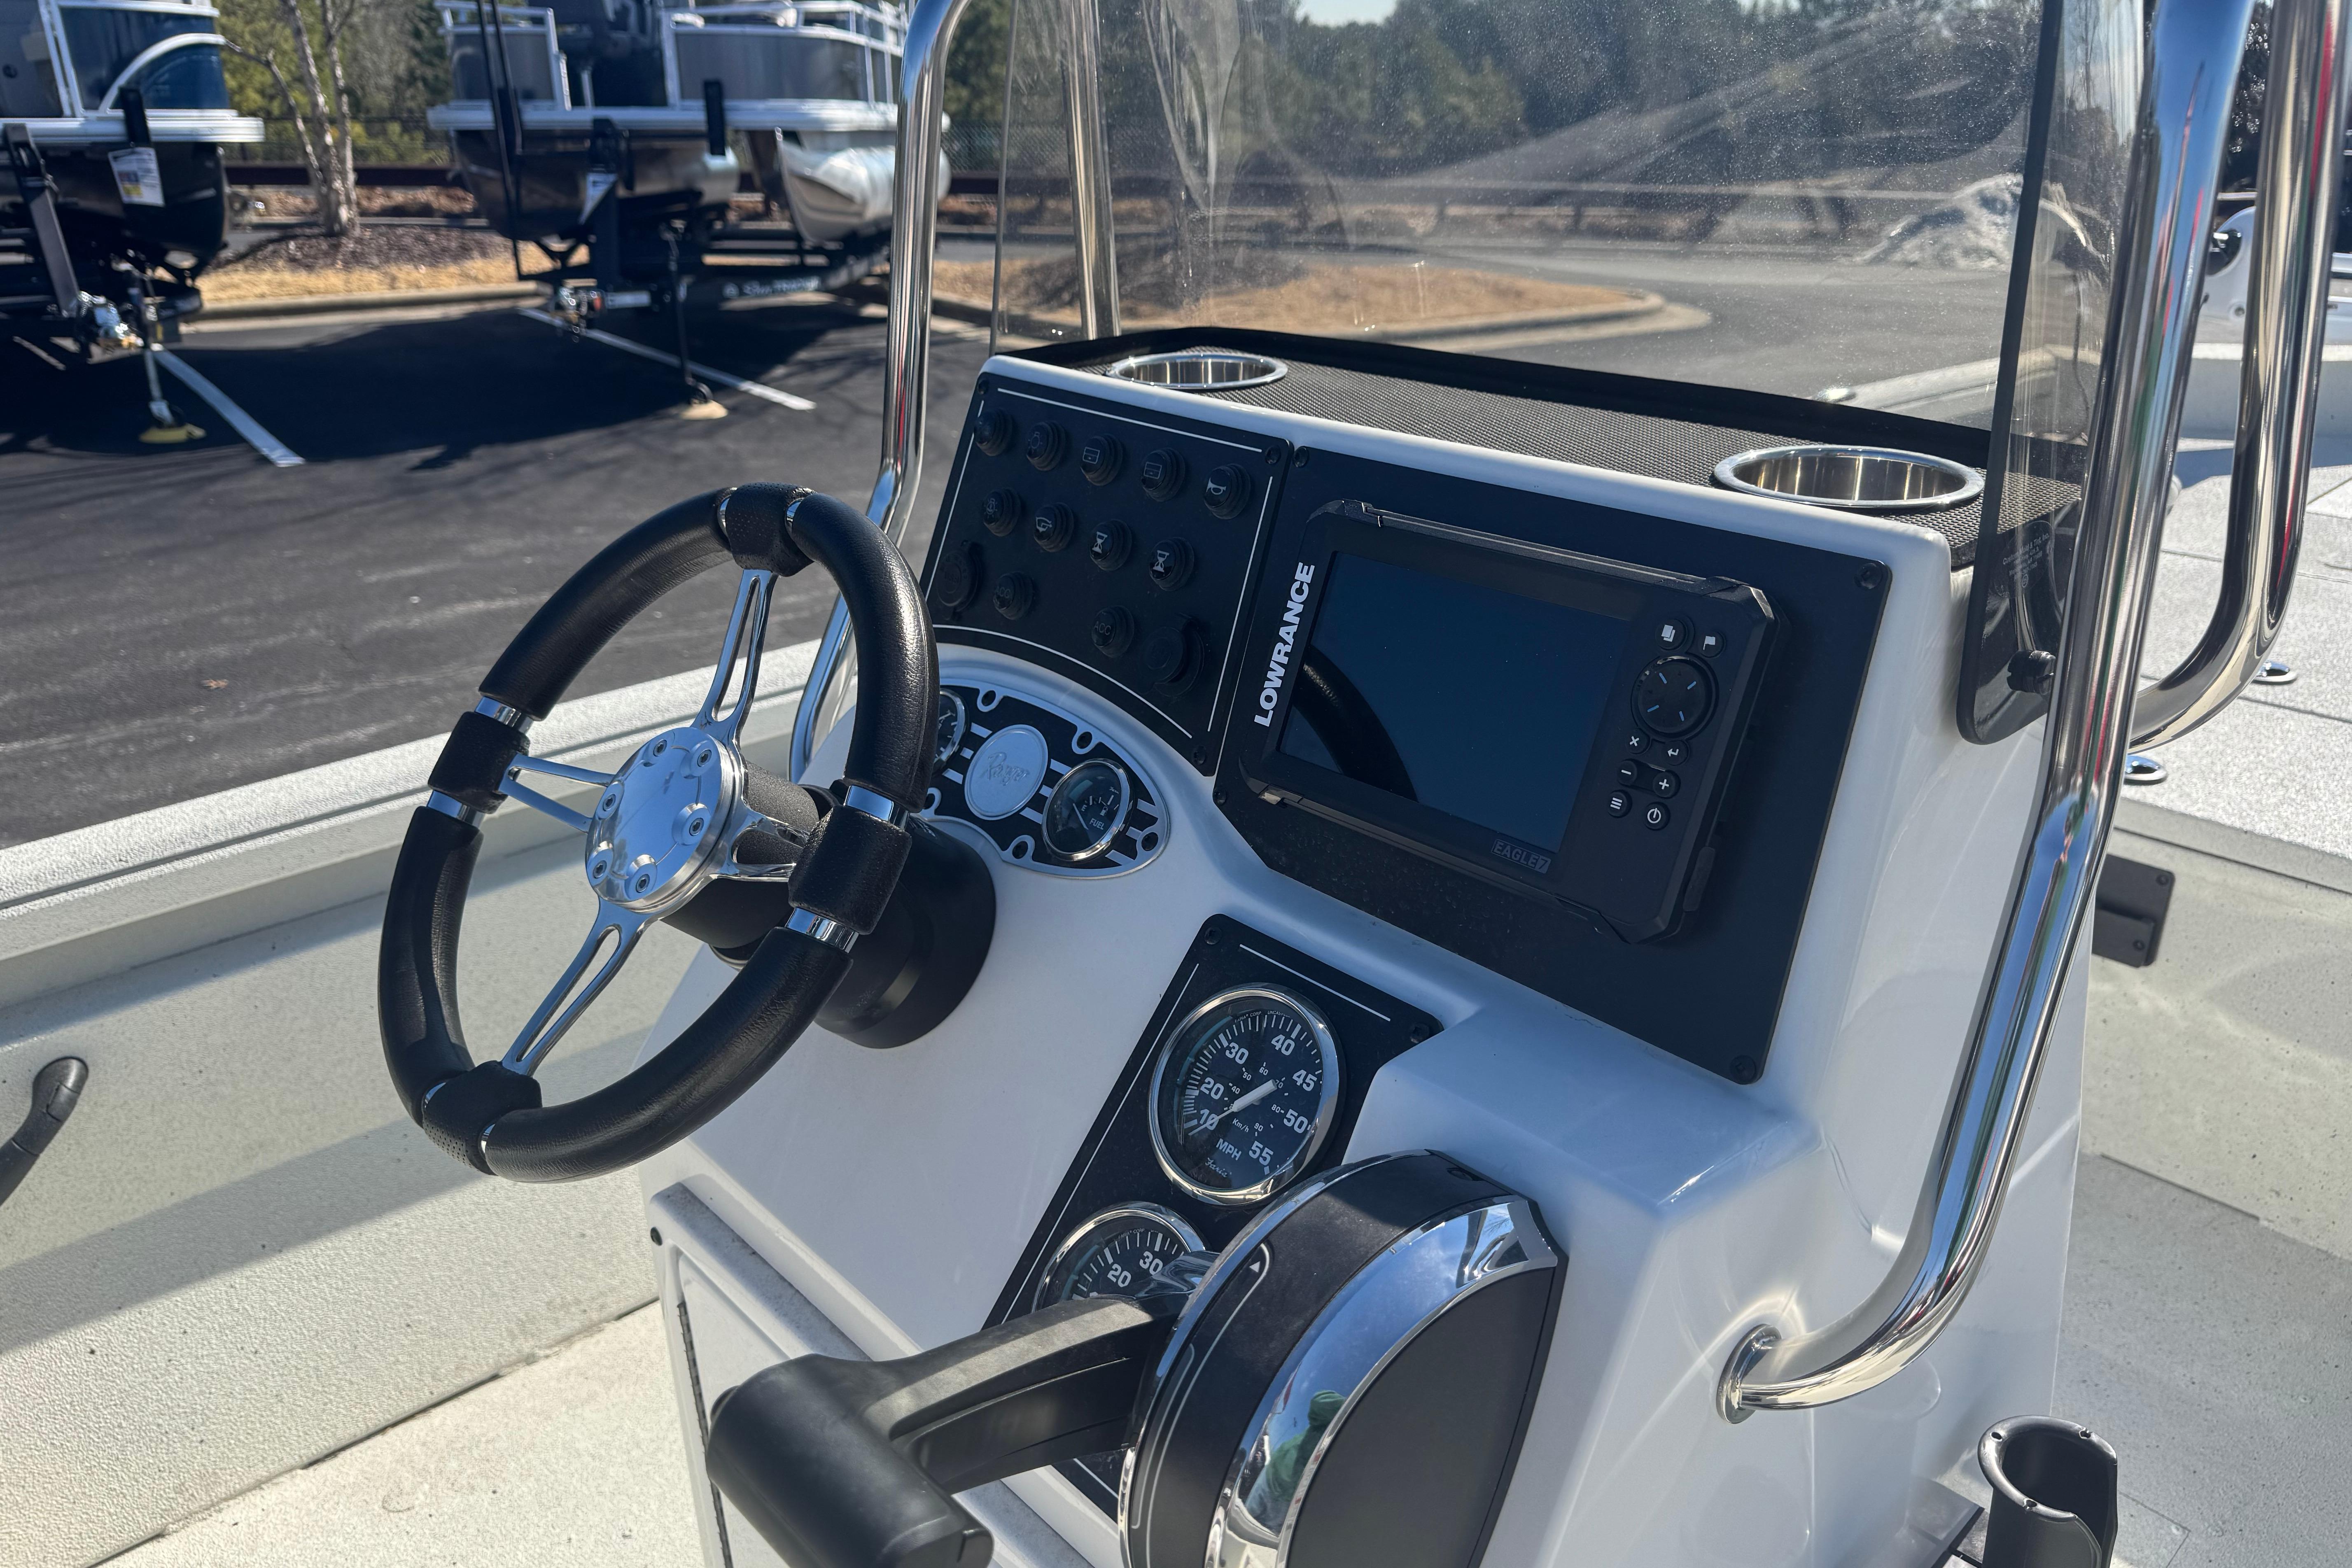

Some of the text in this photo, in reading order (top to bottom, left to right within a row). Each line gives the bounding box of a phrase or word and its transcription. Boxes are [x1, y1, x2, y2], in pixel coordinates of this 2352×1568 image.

[995, 586, 1011, 598] ACC
[1094, 621, 1111, 635] ACC
[1254, 562, 1315, 728] LOWRANCE
[979, 751, 1031, 786] Ranger
[1089, 818, 1105, 831] FUEL
[1225, 1042, 1248, 1064] 30
[1271, 1034, 1295, 1056] 40
[1242, 1072, 1252, 1080] 50
[1259, 1067, 1268, 1076] 60
[1292, 1069, 1317, 1091] 45
[1200, 1077, 1224, 1099] 20
[1231, 1086, 1240, 1094] 40
[1276, 1079, 1283, 1088] 70
[1271, 1104, 1281, 1113] 80
[1199, 1109, 1219, 1130] 10
[1232, 1118, 1249, 1132] Km/h
[1254, 1122, 1263, 1132] 90
[1283, 1108, 1308, 1133] 50
[1216, 1138, 1242, 1160] MPH
[1248, 1141, 1274, 1166] 55
[1139, 1251, 1163, 1275] 30
[1107, 1263, 1132, 1288] 20
